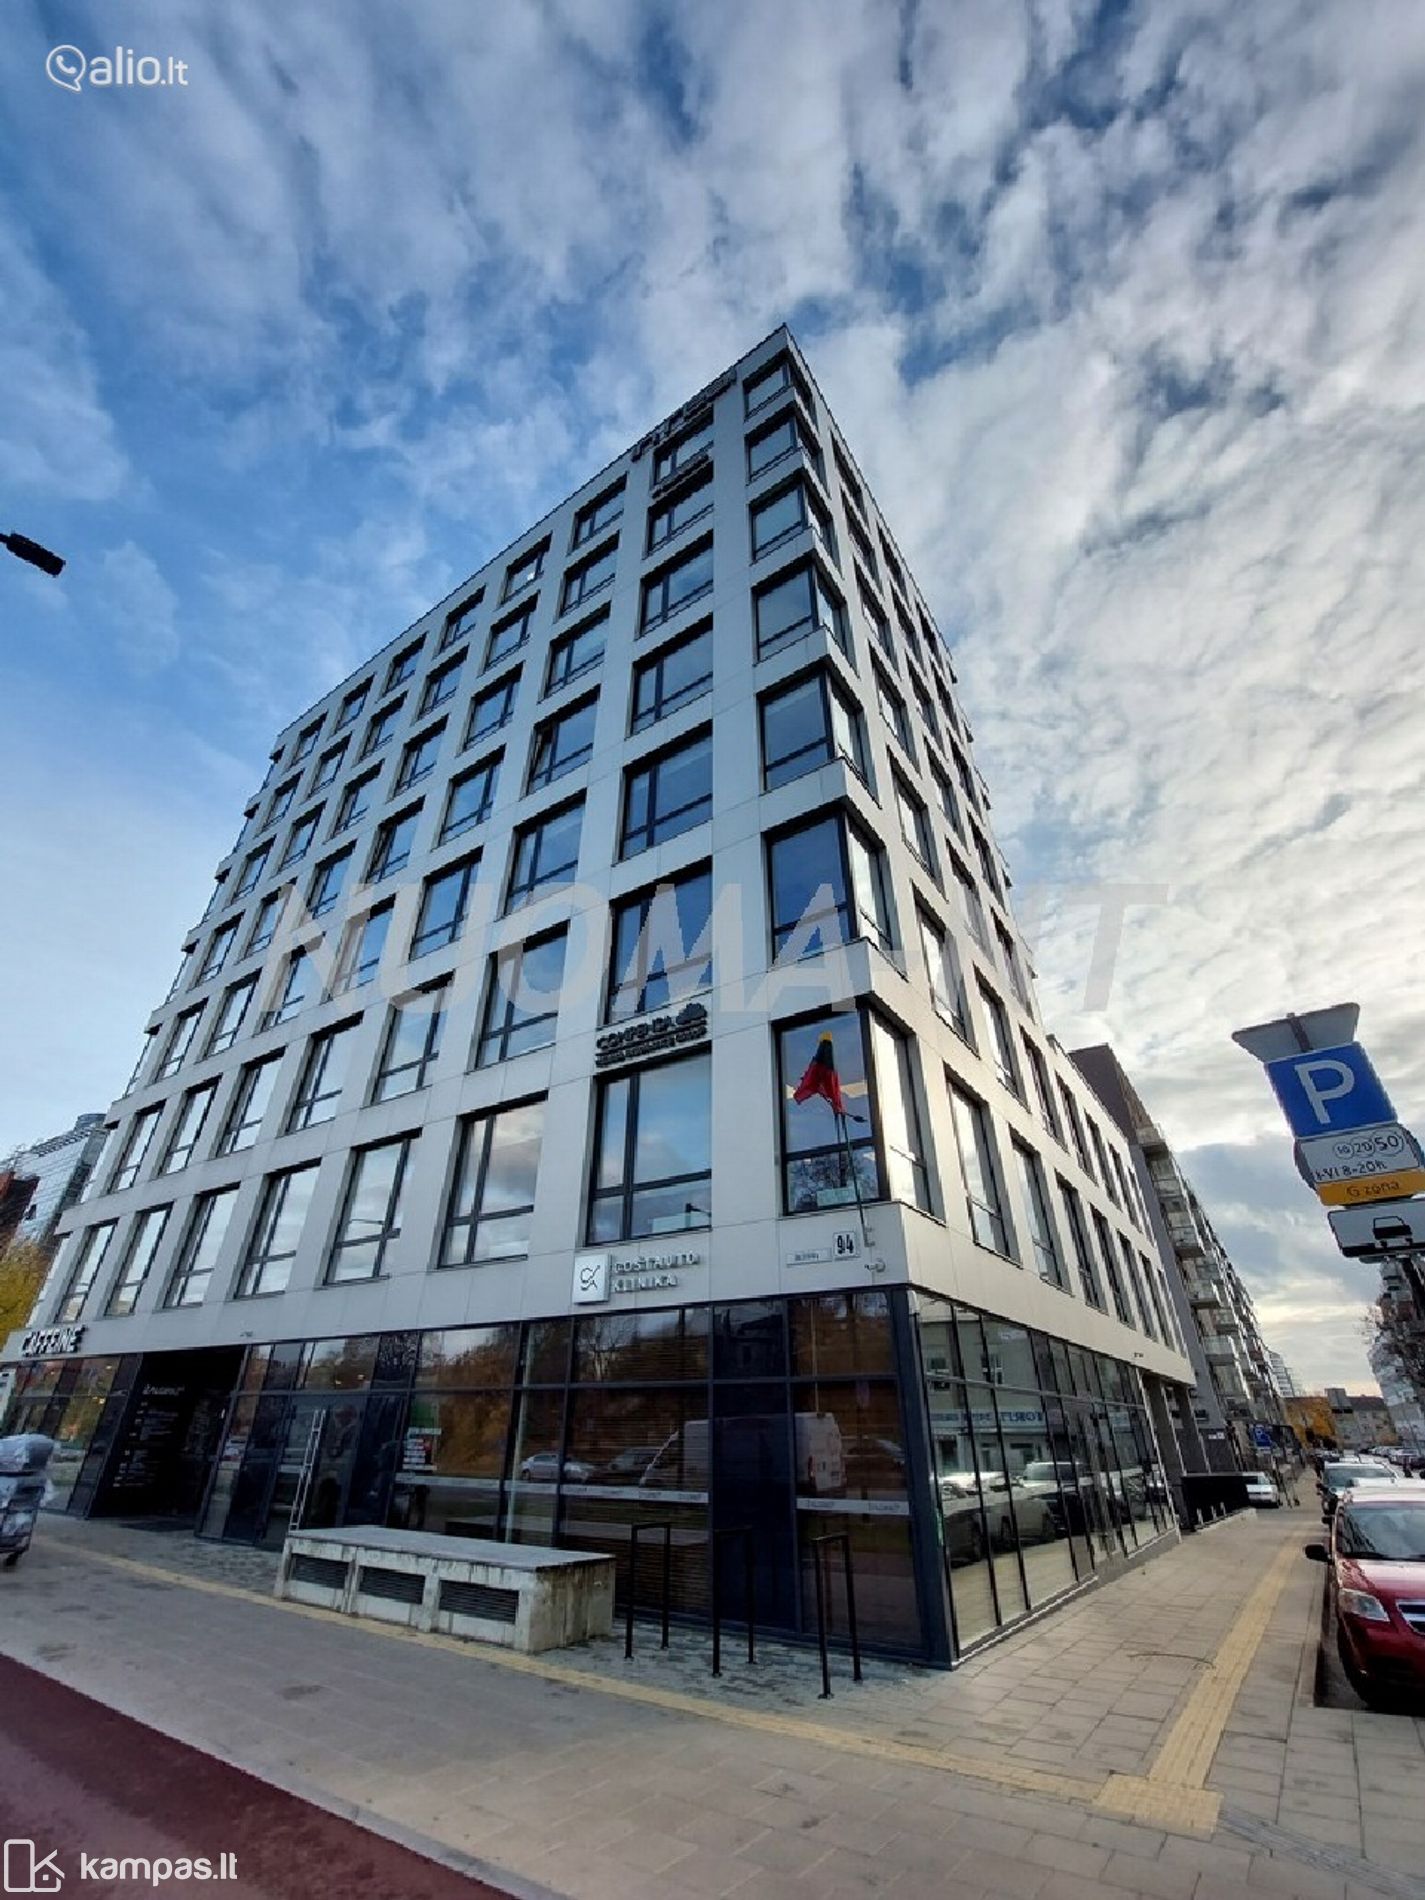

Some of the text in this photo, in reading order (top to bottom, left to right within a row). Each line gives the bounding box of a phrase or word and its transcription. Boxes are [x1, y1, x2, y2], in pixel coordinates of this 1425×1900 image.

[1294, 1059, 1355, 1124] P
[1374, 1134, 1400, 1152] 50
[1364, 1180, 1401, 1194] zona
[837, 1233, 855, 1254] 94
